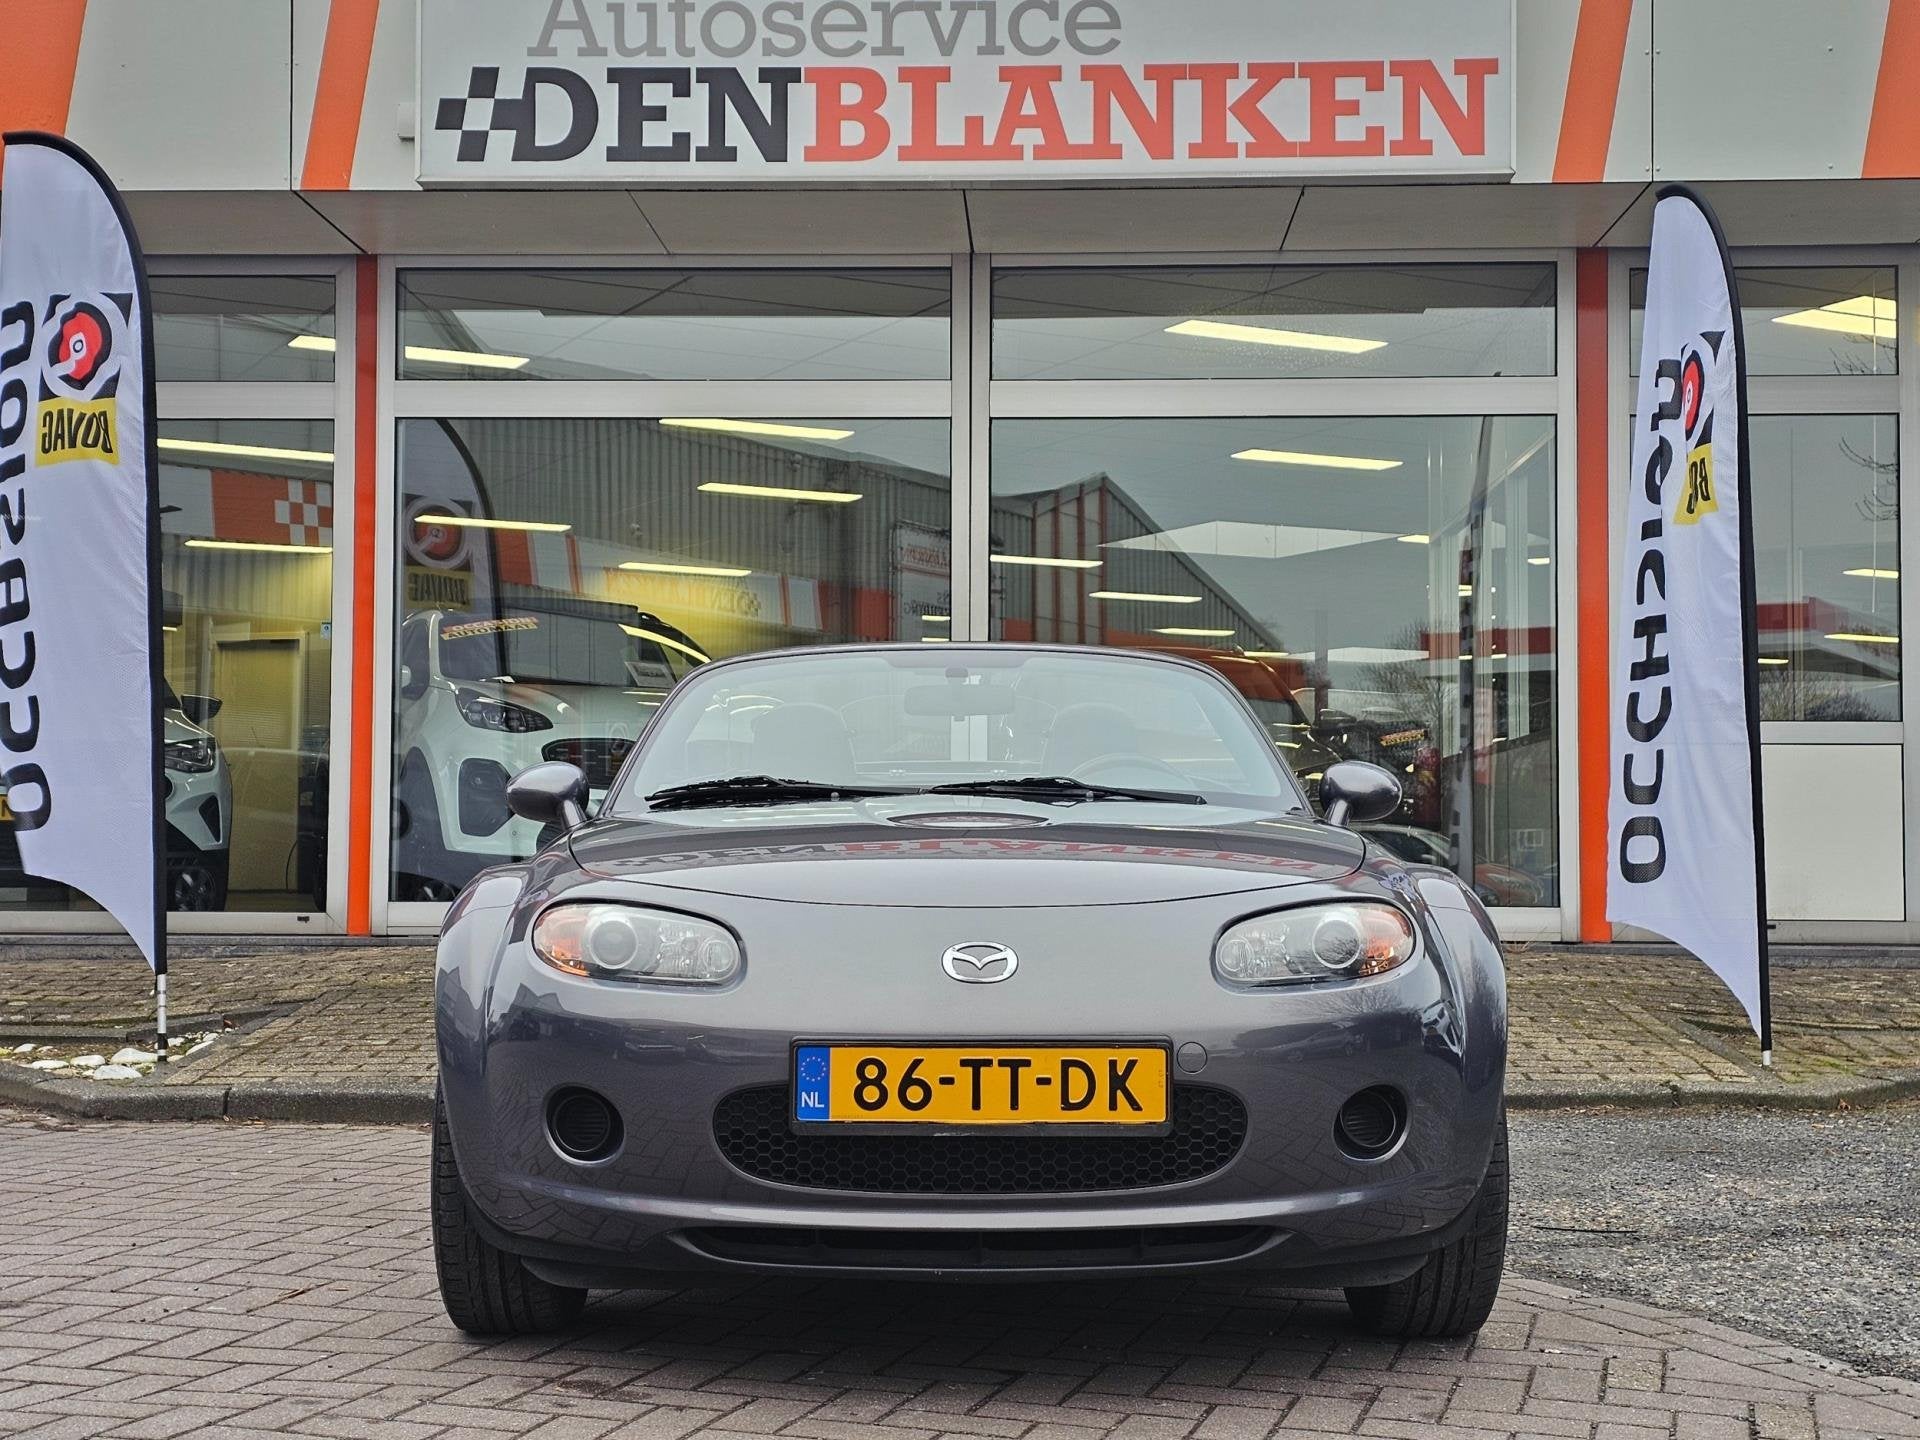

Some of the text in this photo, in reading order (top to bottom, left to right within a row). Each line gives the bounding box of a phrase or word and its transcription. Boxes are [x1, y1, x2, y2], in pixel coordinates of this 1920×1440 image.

[527, 0, 1122, 58] Autoservice
[800, 1092, 825, 1108] NL
[852, 1057, 1144, 1112] 86-TT-DK
